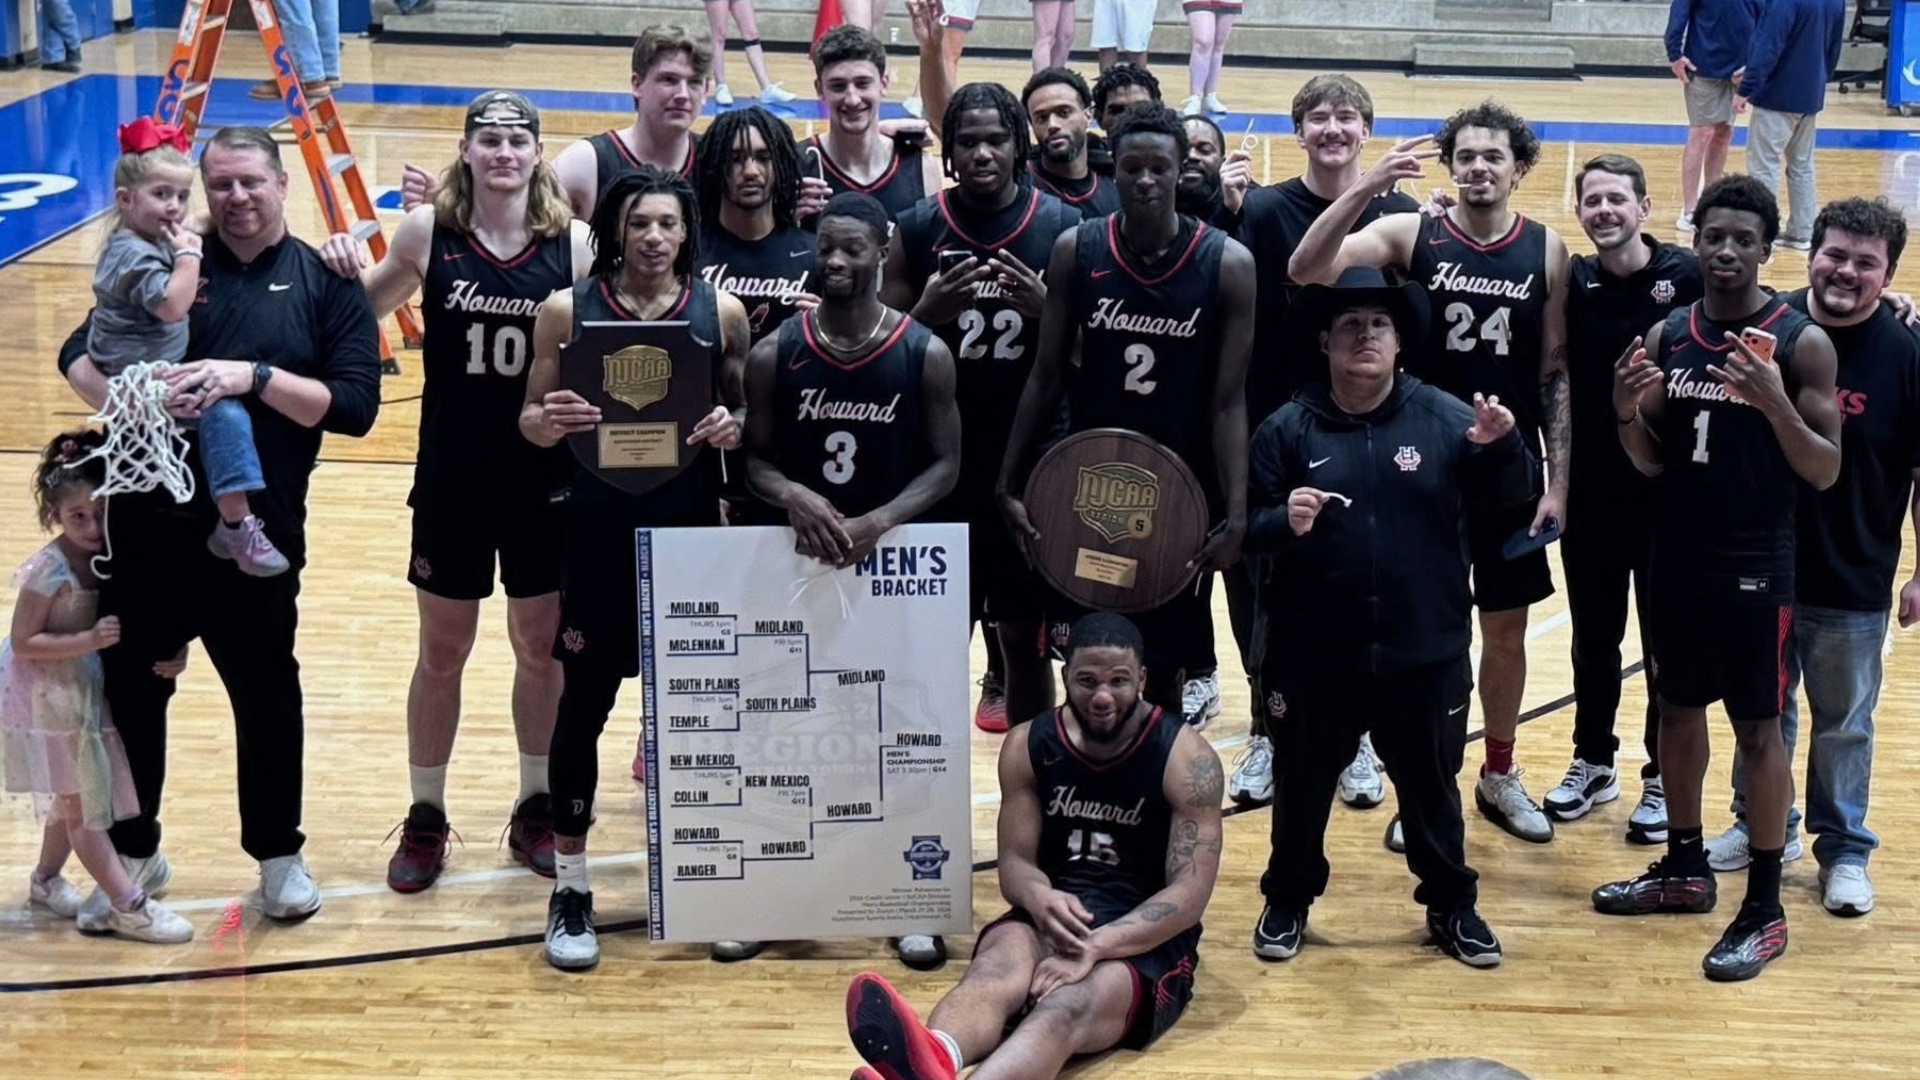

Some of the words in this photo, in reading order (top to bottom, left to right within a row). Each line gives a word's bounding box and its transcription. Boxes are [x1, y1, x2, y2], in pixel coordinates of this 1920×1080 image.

[1428, 261, 1534, 300] Howard
[1088, 297, 1202, 338] Howard
[957, 309, 1025, 360] 22
[1444, 302, 1512, 355] 24
[466, 322, 526, 376] 10
[606, 358, 669, 388] NJCAA
[1124, 343, 1157, 395] 2
[798, 388, 900, 424] Howard
[1692, 410, 1710, 464] 1
[822, 431, 857, 485] 3
[1078, 471, 1155, 508] NJCAA
[1135, 519, 1145, 532] 5
[855, 546, 948, 577] MEN'S
[871, 579, 948, 597] BRACKET
[670, 602, 720, 615] MIDLAND
[755, 620, 804, 634] MIDLAND
[669, 639, 725, 652] MCLENNAN
[669, 679, 701, 691] SOUTH
[705, 678, 741, 691] PLAINS
[837, 669, 886, 687] MIDLAND
[746, 698, 778, 710] SOUTH
[781, 696, 817, 710] PLAINS
[669, 715, 710, 728] TEMPLE
[896, 733, 942, 747] HOWARD
[670, 755, 693, 766] NEW
[695, 754, 735, 766] MEXICO
[745, 775, 768, 788] NEW
[770, 774, 810, 788] MEXICO
[674, 790, 709, 803] COLLIN
[826, 802, 872, 818] HOWARD
[1046, 785, 1145, 826] Howard
[674, 827, 720, 840] HOWARD
[761, 841, 807, 855] HOWARD
[677, 864, 717, 877] RANGER
